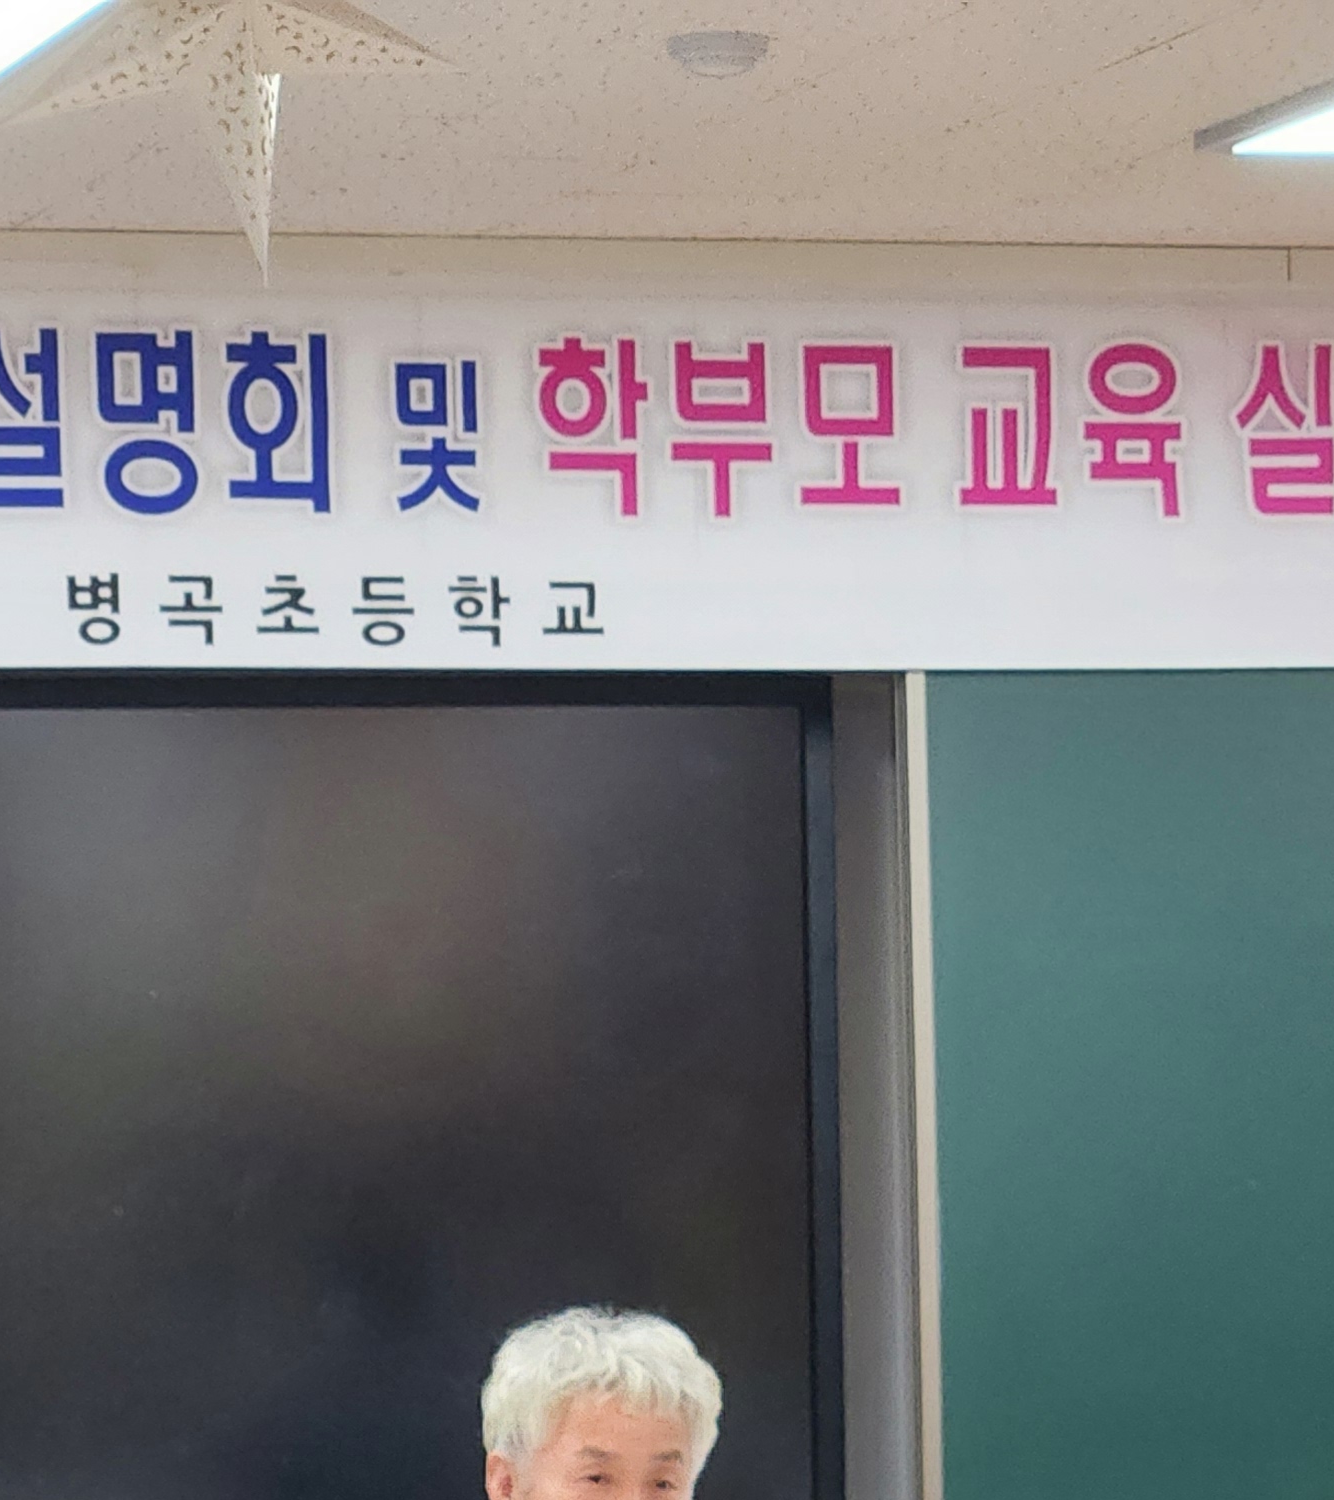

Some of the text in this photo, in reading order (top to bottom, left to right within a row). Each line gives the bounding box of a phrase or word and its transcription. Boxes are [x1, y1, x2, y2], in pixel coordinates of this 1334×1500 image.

[394, 359, 481, 513] 및
[537, 336, 902, 517] 학부모
[958, 342, 1183, 518] 교육
[66, 571, 605, 648] 병곡초등학교
